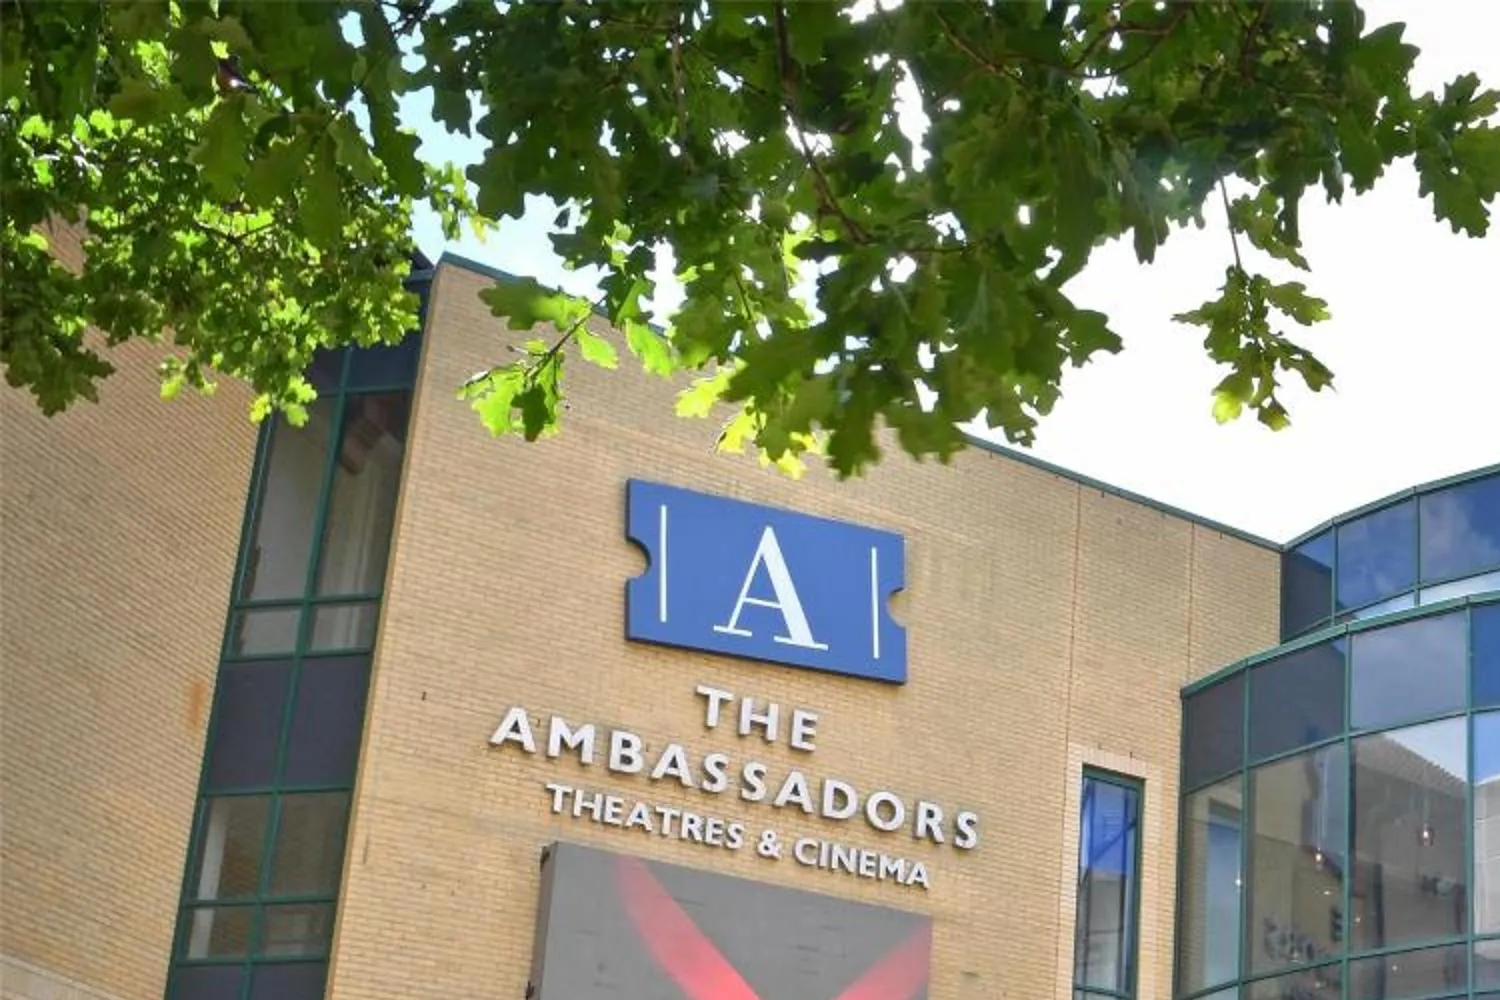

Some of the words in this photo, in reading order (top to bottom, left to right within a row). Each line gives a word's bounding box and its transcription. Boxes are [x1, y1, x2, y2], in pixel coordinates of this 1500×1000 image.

[713, 526, 829, 650] A
[696, 684, 820, 752] THE
[489, 706, 981, 851] AMBASSADORS
[545, 783, 745, 851] THEATRES
[757, 830, 783, 859] &
[793, 837, 931, 890] CINEMA
